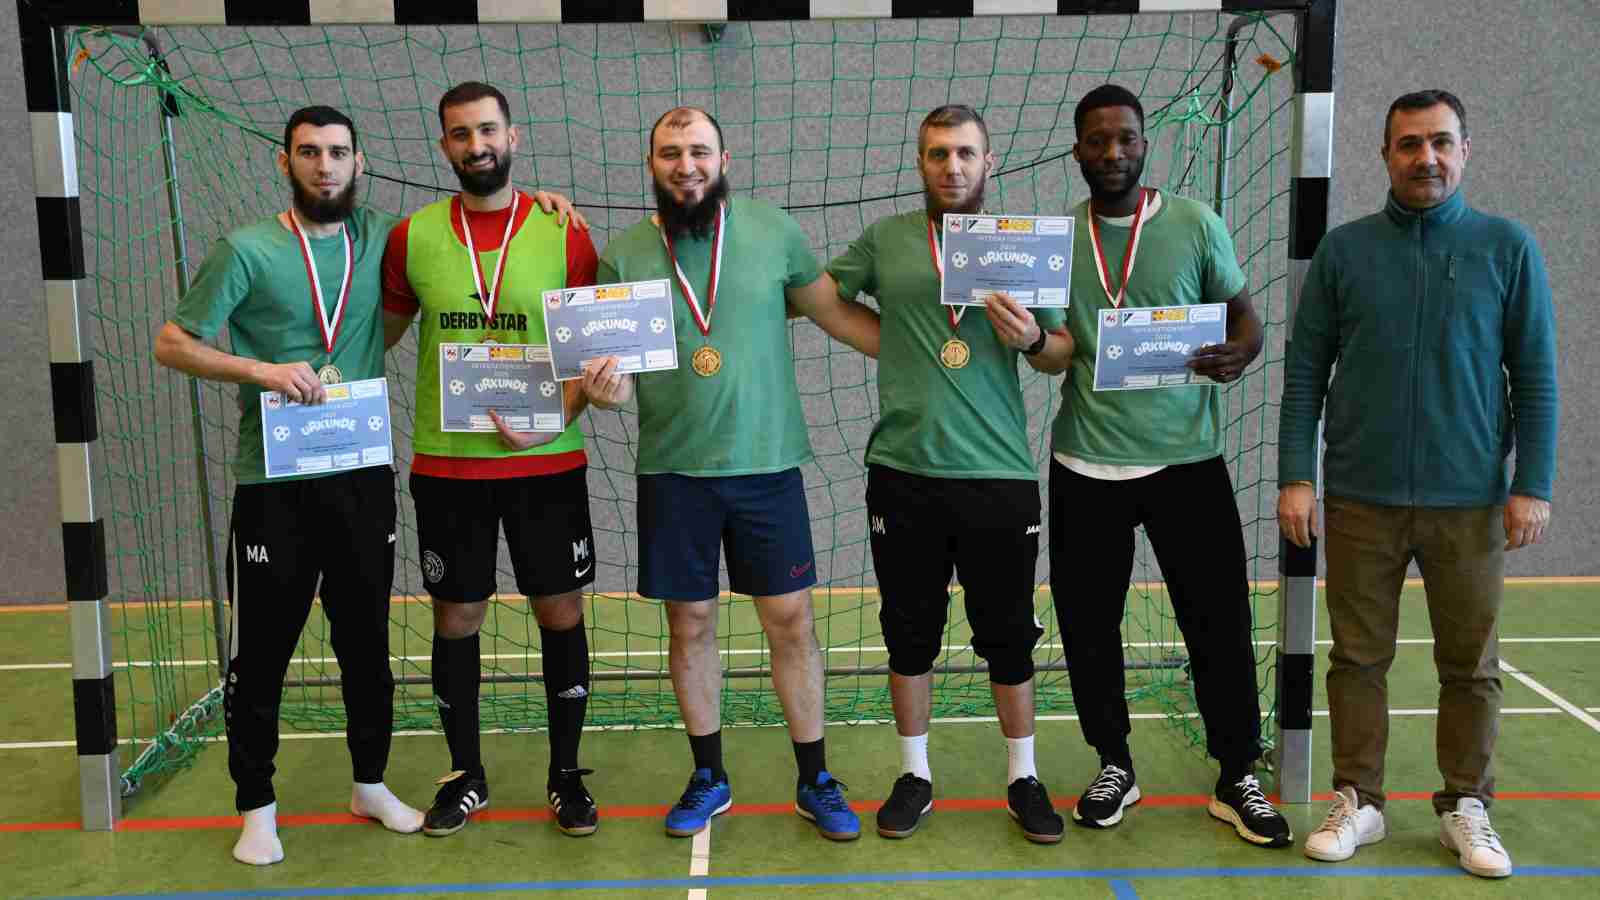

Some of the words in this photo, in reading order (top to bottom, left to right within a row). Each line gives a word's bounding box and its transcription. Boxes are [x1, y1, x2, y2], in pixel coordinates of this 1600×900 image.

[978, 251, 1037, 268] URKUNDE
[440, 312, 527, 331] DERBYSTAR
[582, 318, 640, 337] URKUNDE
[1134, 341, 1192, 357] URKUNDE
[474, 377, 529, 394] URKUNDE
[301, 417, 359, 436] URKUNDE
[246, 545, 269, 563] MA
